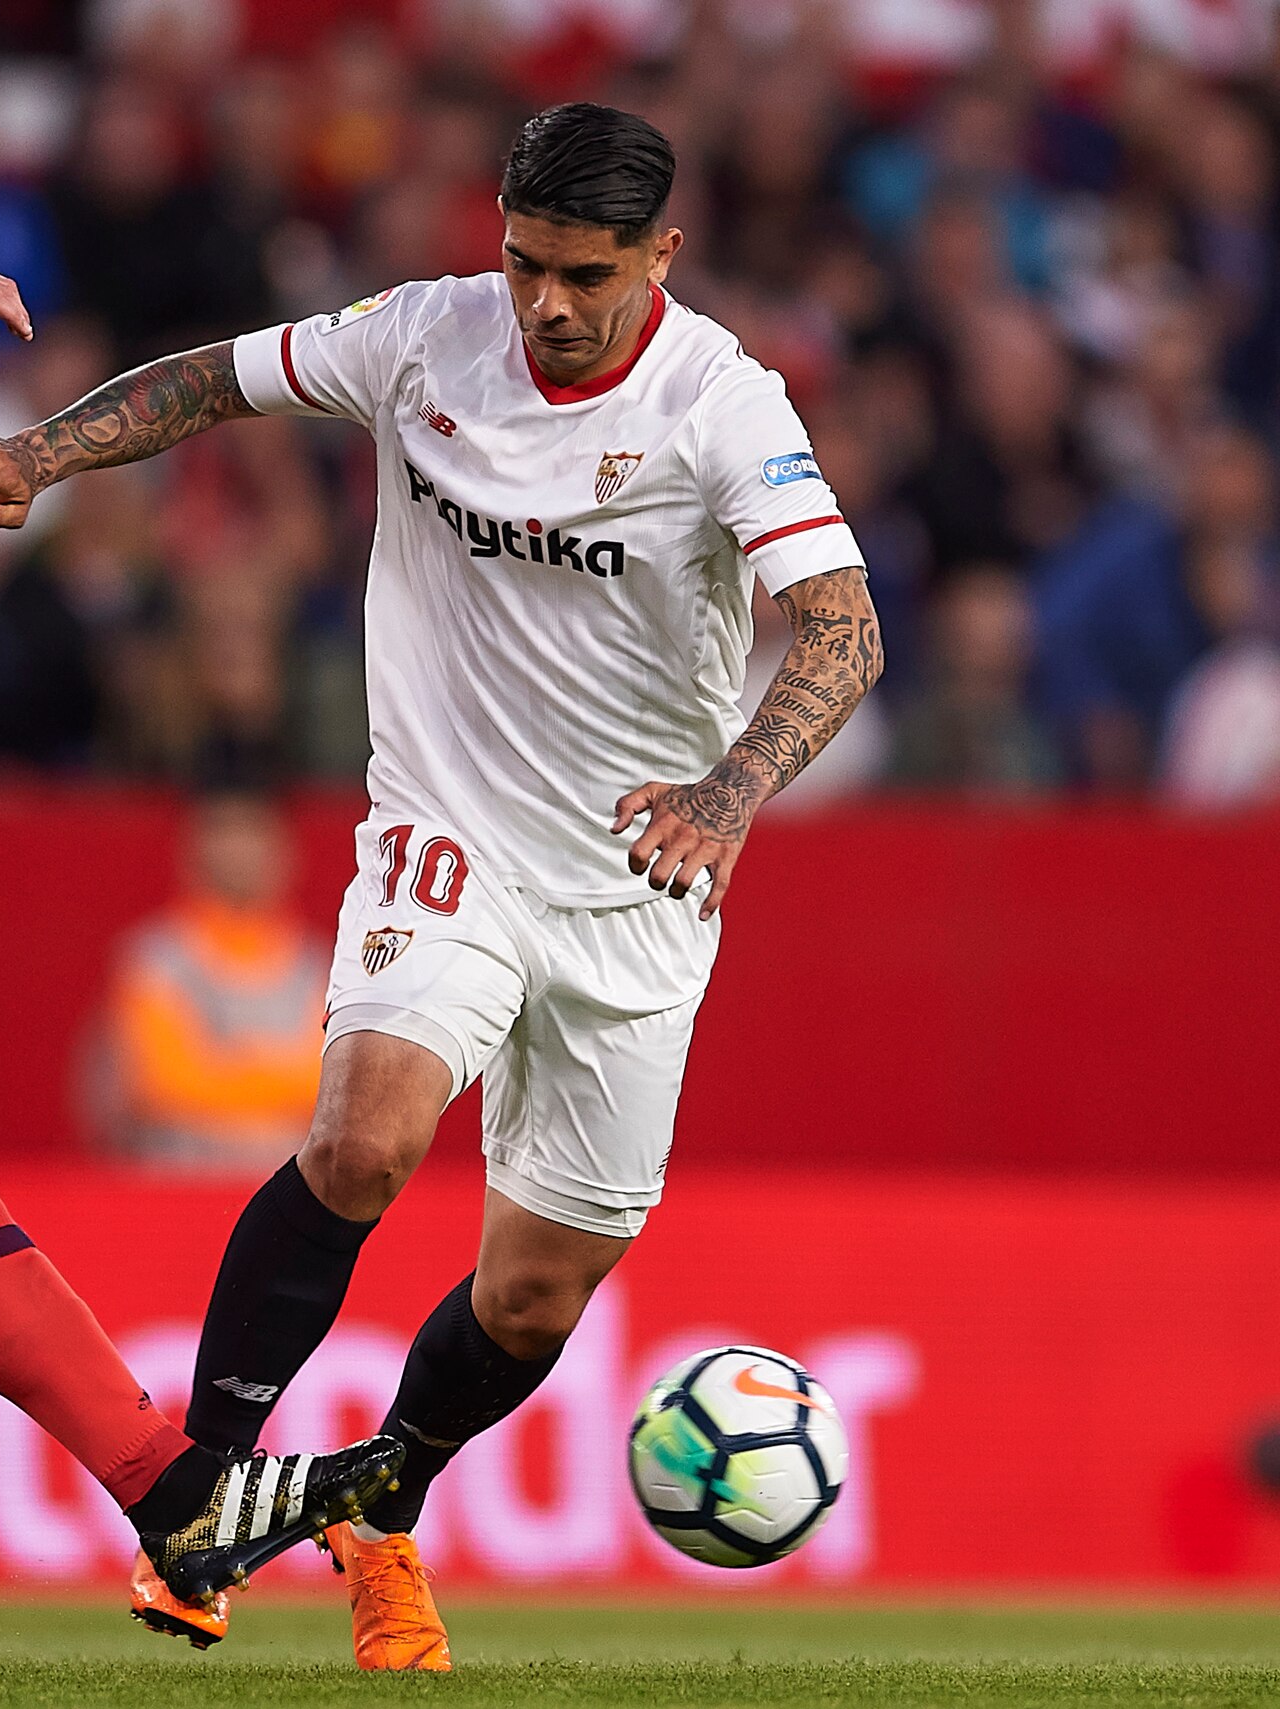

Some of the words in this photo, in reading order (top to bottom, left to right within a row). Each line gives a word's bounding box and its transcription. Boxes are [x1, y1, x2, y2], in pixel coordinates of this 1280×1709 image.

[404, 458, 625, 578] Playtika
[771, 690, 825, 728] Daniel
[775, 667, 841, 711] Claudia
[378, 824, 470, 917] 10
